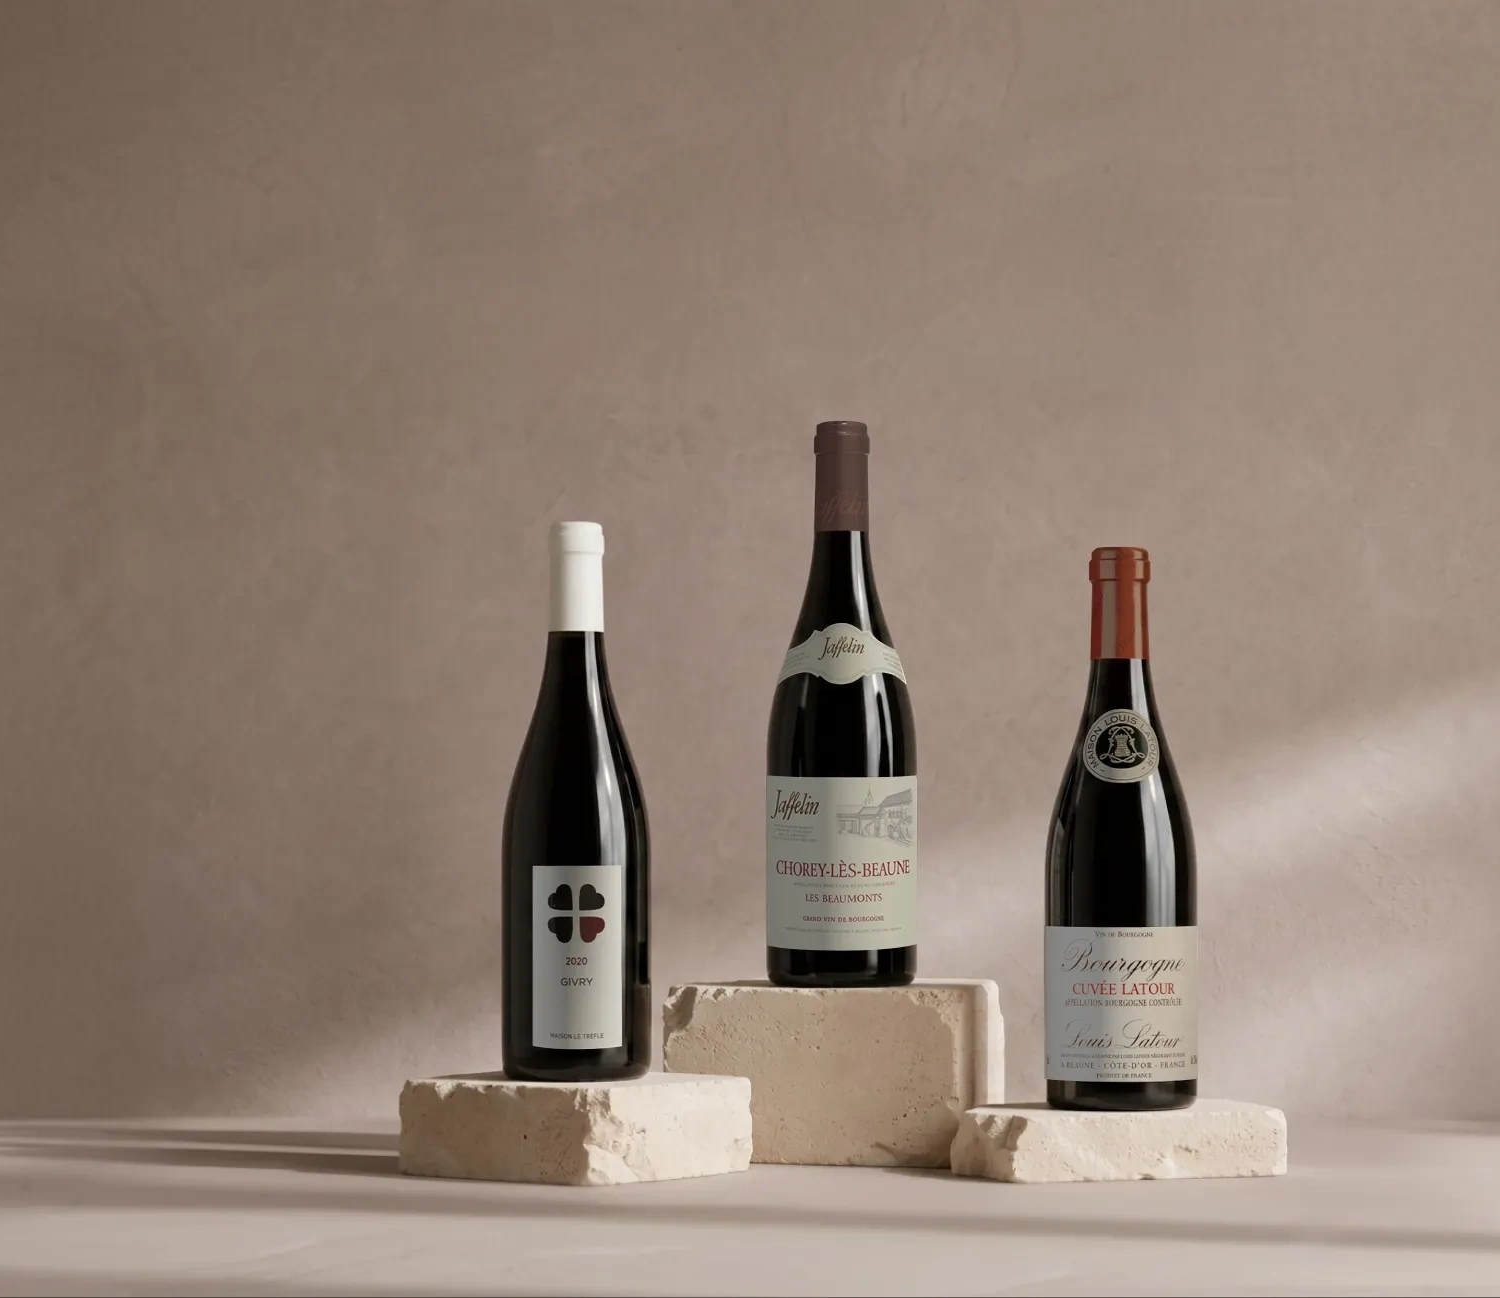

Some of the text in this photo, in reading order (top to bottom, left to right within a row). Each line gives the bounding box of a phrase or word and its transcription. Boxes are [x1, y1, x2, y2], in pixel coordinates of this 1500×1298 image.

[817, 635, 865, 661] Jaffelin
[1087, 714, 1156, 769] MAISON LOUIS LATOUR
[770, 789, 820, 821] Jaffelin
[776, 859, 911, 878] CHOREY-LÈS-BEAUNE
[805, 892, 883, 904] LES BEAUMONTS
[848, 915, 885, 923] BOURGOGNE
[565, 956, 588, 966] 2020
[1061, 938, 1186, 983] Bourgogne
[560, 977, 594, 987] GIVRY
[1072, 979, 1176, 995] CUVÉE LATOUR
[1064, 998, 1103, 1007] APPELLATION
[1104, 999, 1148, 1007] BOURGOGNE
[549, 1032, 573, 1040] MAISON
[1061, 1018, 1185, 1049] Louis Latour
[1103, 1060, 1152, 1070] CÔTE-D'OR
[1160, 1060, 1186, 1069] FRANCE
